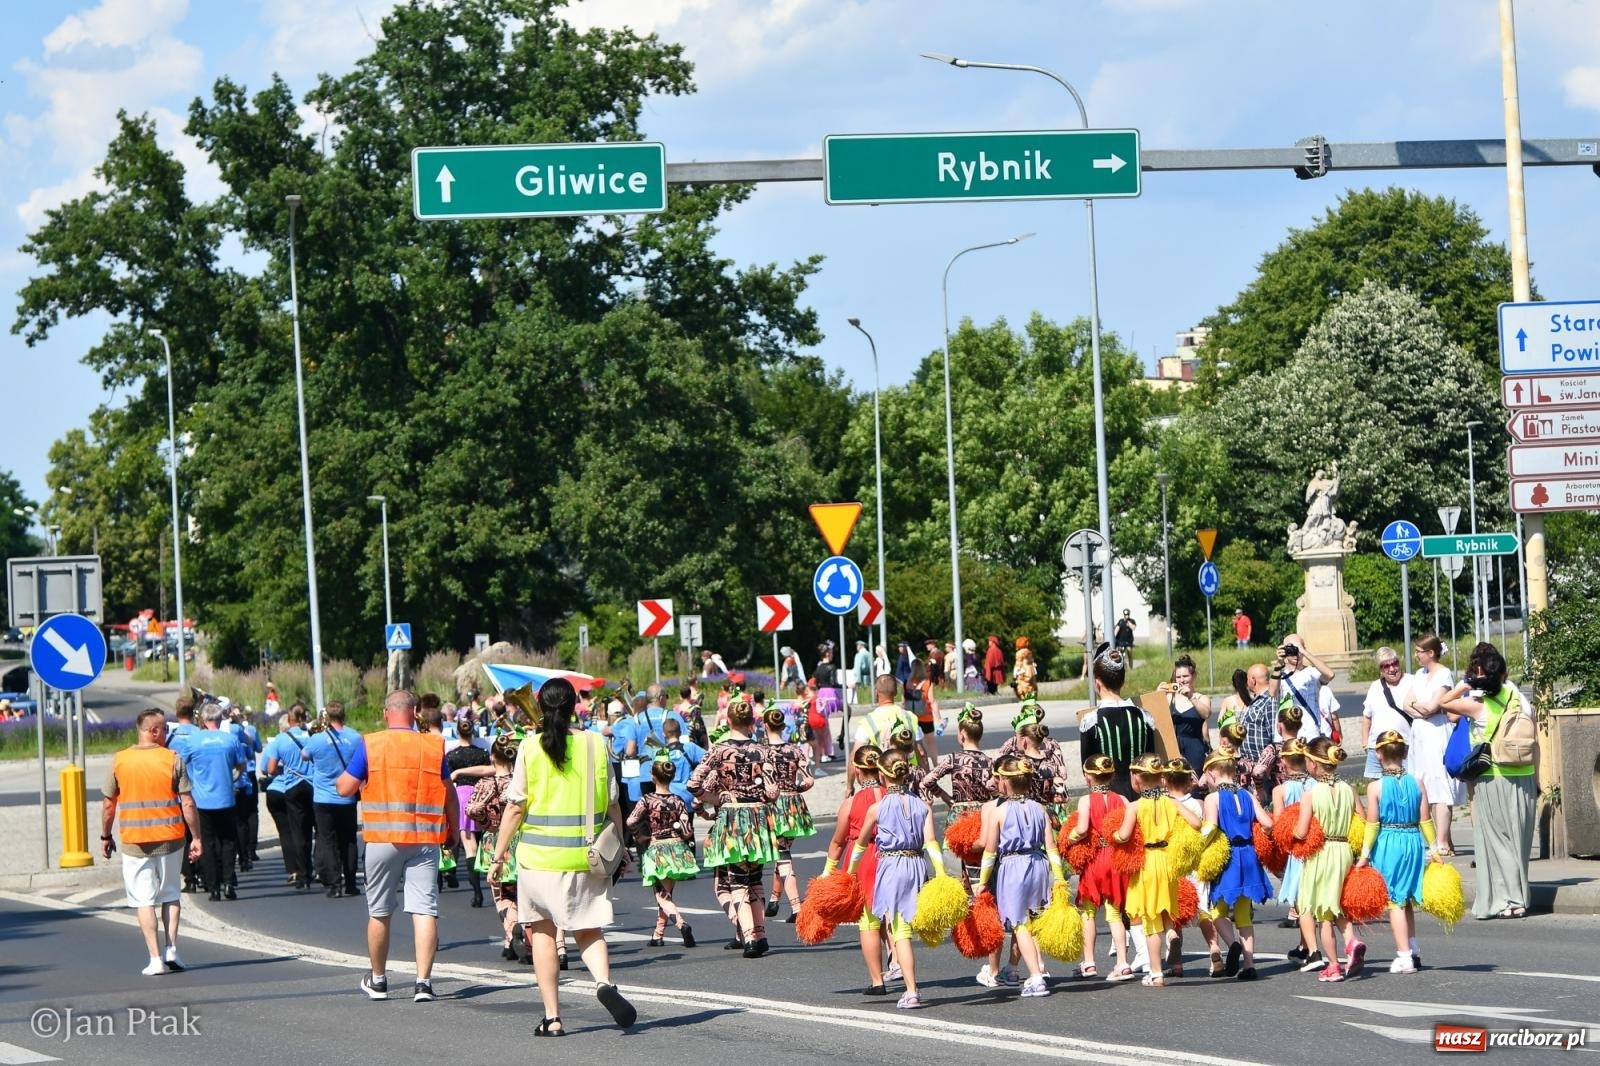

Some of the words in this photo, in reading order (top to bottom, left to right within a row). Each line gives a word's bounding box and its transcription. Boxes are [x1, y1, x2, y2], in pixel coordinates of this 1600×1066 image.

[938, 150, 1052, 190] Rybnik
[515, 164, 648, 196] Gliwice
[1551, 342, 1599, 362] Powi
[1560, 389, 1600, 400] św.Jan
[1564, 451, 1598, 466] Mini
[1566, 492, 1600, 504] Bramy
[1456, 538, 1498, 554] Rybnik
